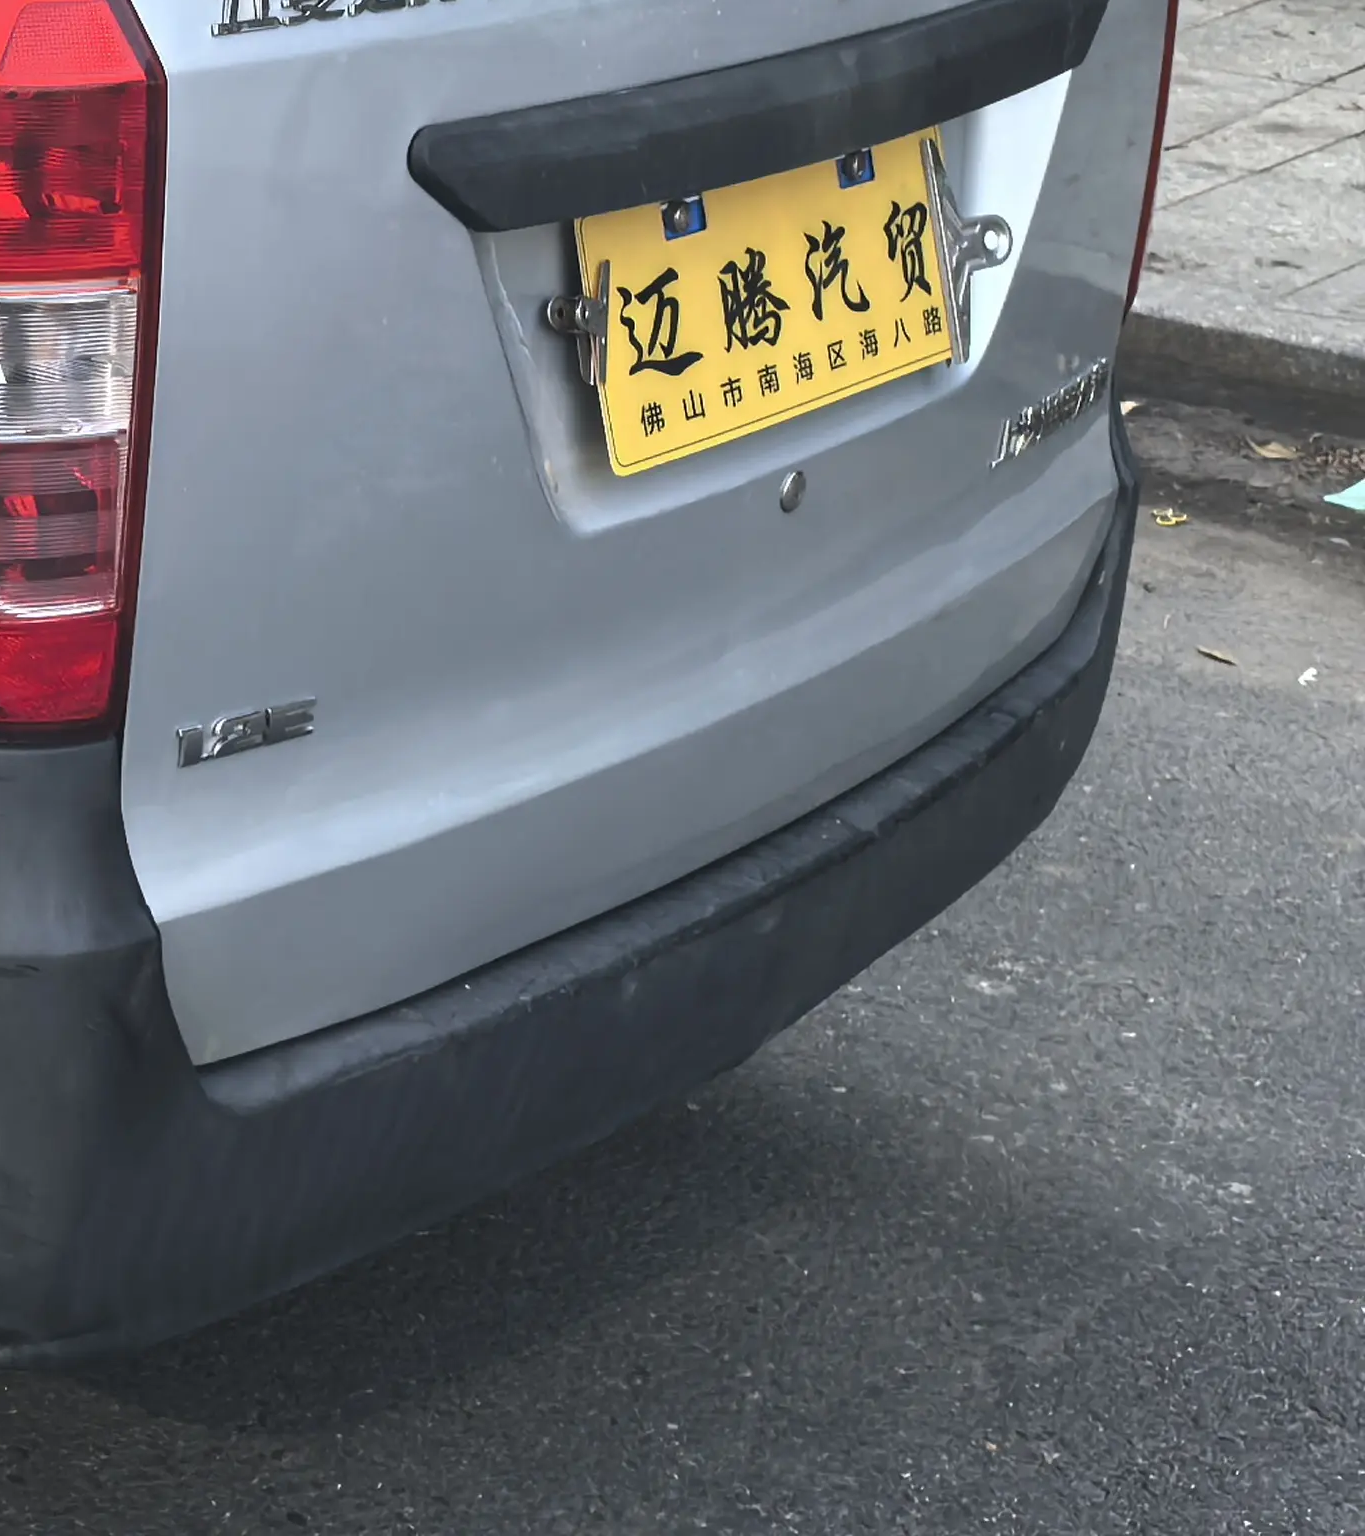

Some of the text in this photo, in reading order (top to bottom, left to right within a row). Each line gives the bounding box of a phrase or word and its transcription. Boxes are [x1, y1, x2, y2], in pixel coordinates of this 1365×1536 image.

[616, 200, 932, 377] 迈腾汽贸
[640, 306, 943, 438] 佛山市南海区海八路
